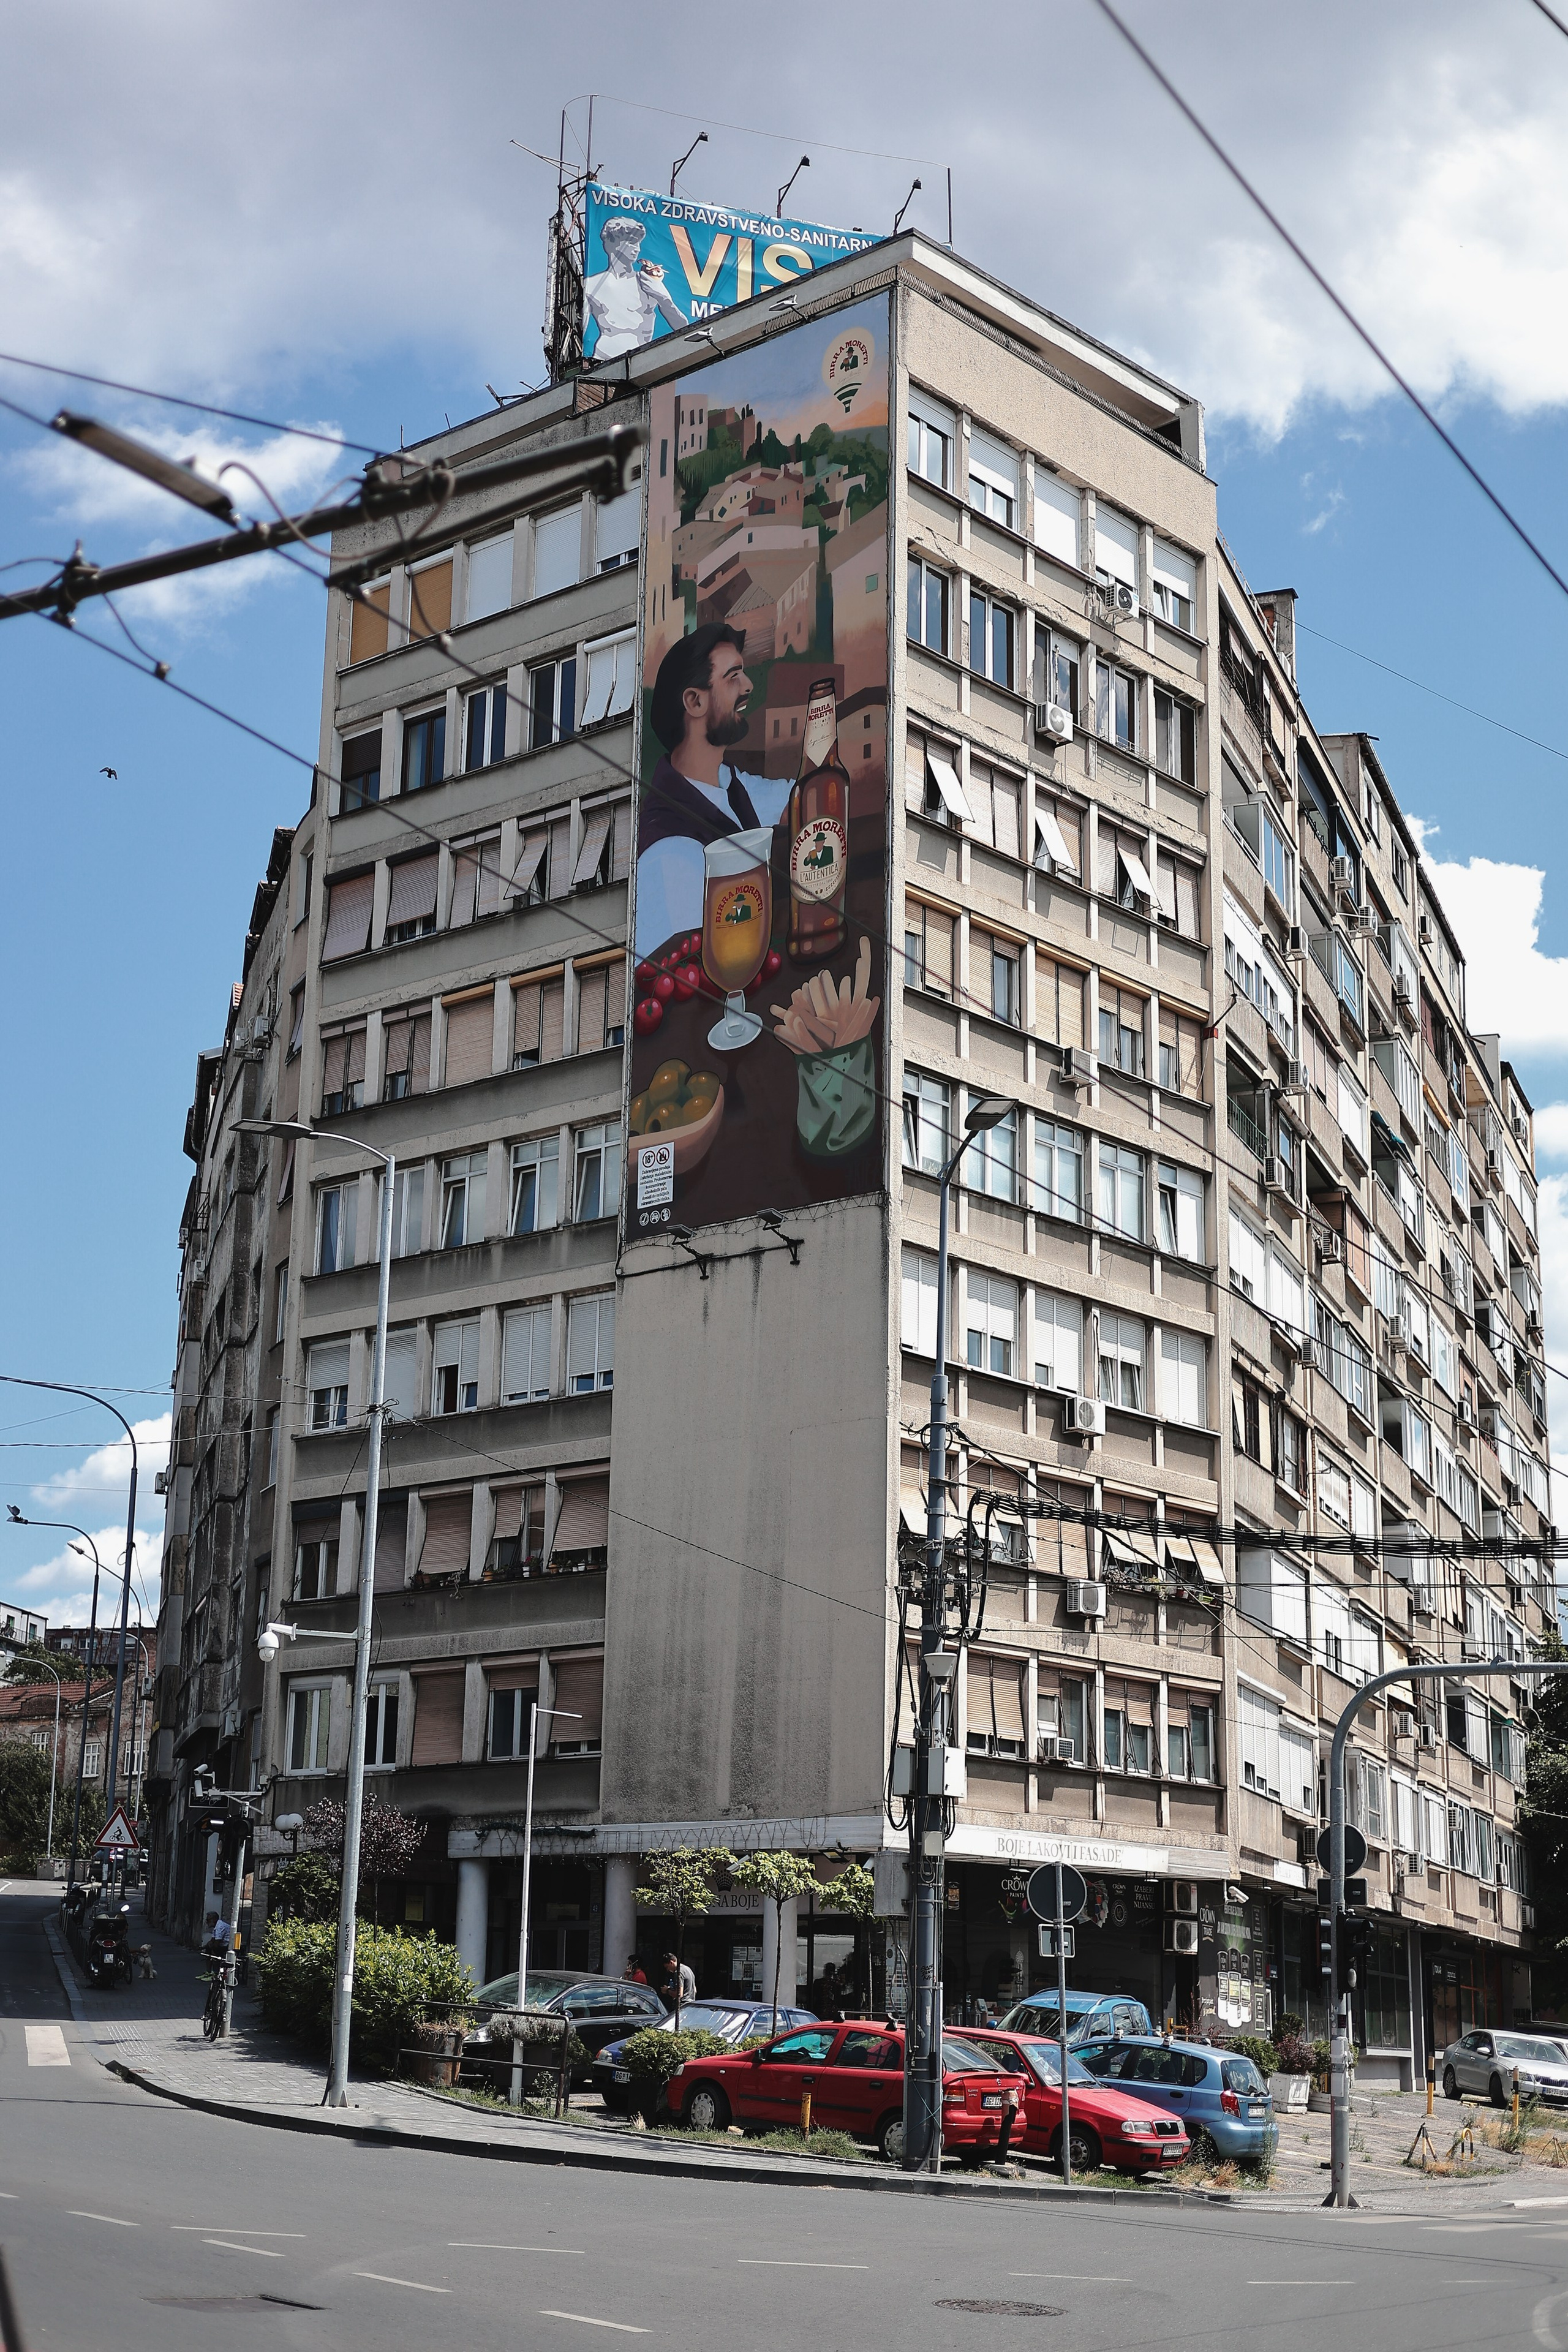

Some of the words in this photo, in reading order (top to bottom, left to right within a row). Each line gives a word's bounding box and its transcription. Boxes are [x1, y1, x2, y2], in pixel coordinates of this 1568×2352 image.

[592, 190, 657, 214] VISOKA
[669, 224, 815, 303] VIS
[691, 300, 729, 318] ME
[829, 346, 845, 379] BIRRA
[845, 340, 869, 366] MORETTI
[808, 707, 834, 721] MORETTI
[810, 703, 831, 714] BIRRA
[792, 829, 812, 871] BIRRA
[813, 821, 846, 858] MORETTI
[800, 863, 839, 883] L'AUTENTICA
[715, 891, 735, 923] BIRRA
[735, 885, 763, 912] MORETTI
[645, 1154, 654, 1164] 18+
[997, 1838, 1025, 1856] BOJE
[1080, 1846, 1121, 1863] FASADE
[731, 1894, 759, 1910] BOJE
[1200, 1907, 1215, 1923] CROWN
[1203, 1927, 1213, 1936] TRADE
